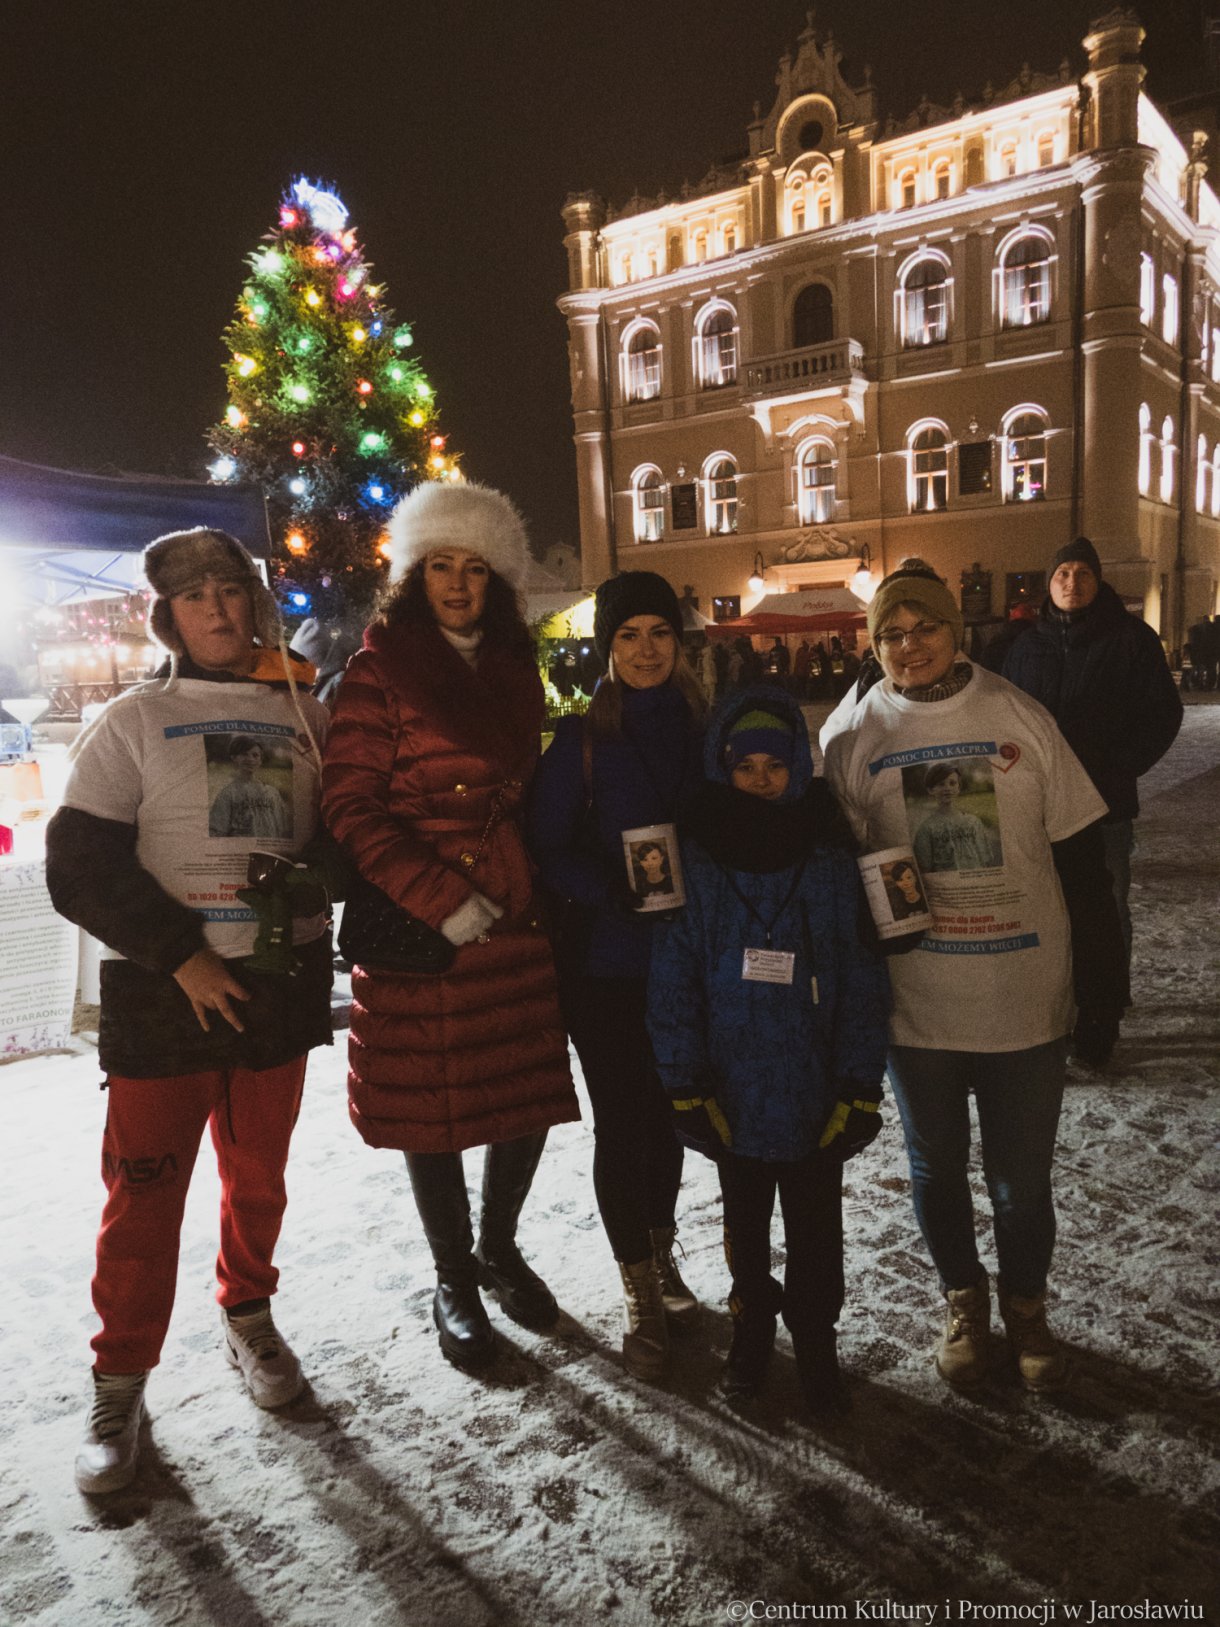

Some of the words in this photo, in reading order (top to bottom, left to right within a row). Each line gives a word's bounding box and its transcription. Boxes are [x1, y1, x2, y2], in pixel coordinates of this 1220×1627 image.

[183, 723, 224, 734] POMOC
[226, 721, 248, 730] DLA
[883, 752, 921, 766] POMOC
[923, 749, 944, 759] DLA
[946, 744, 989, 756] KACPRA
[104, 1151, 179, 1183] NASA
